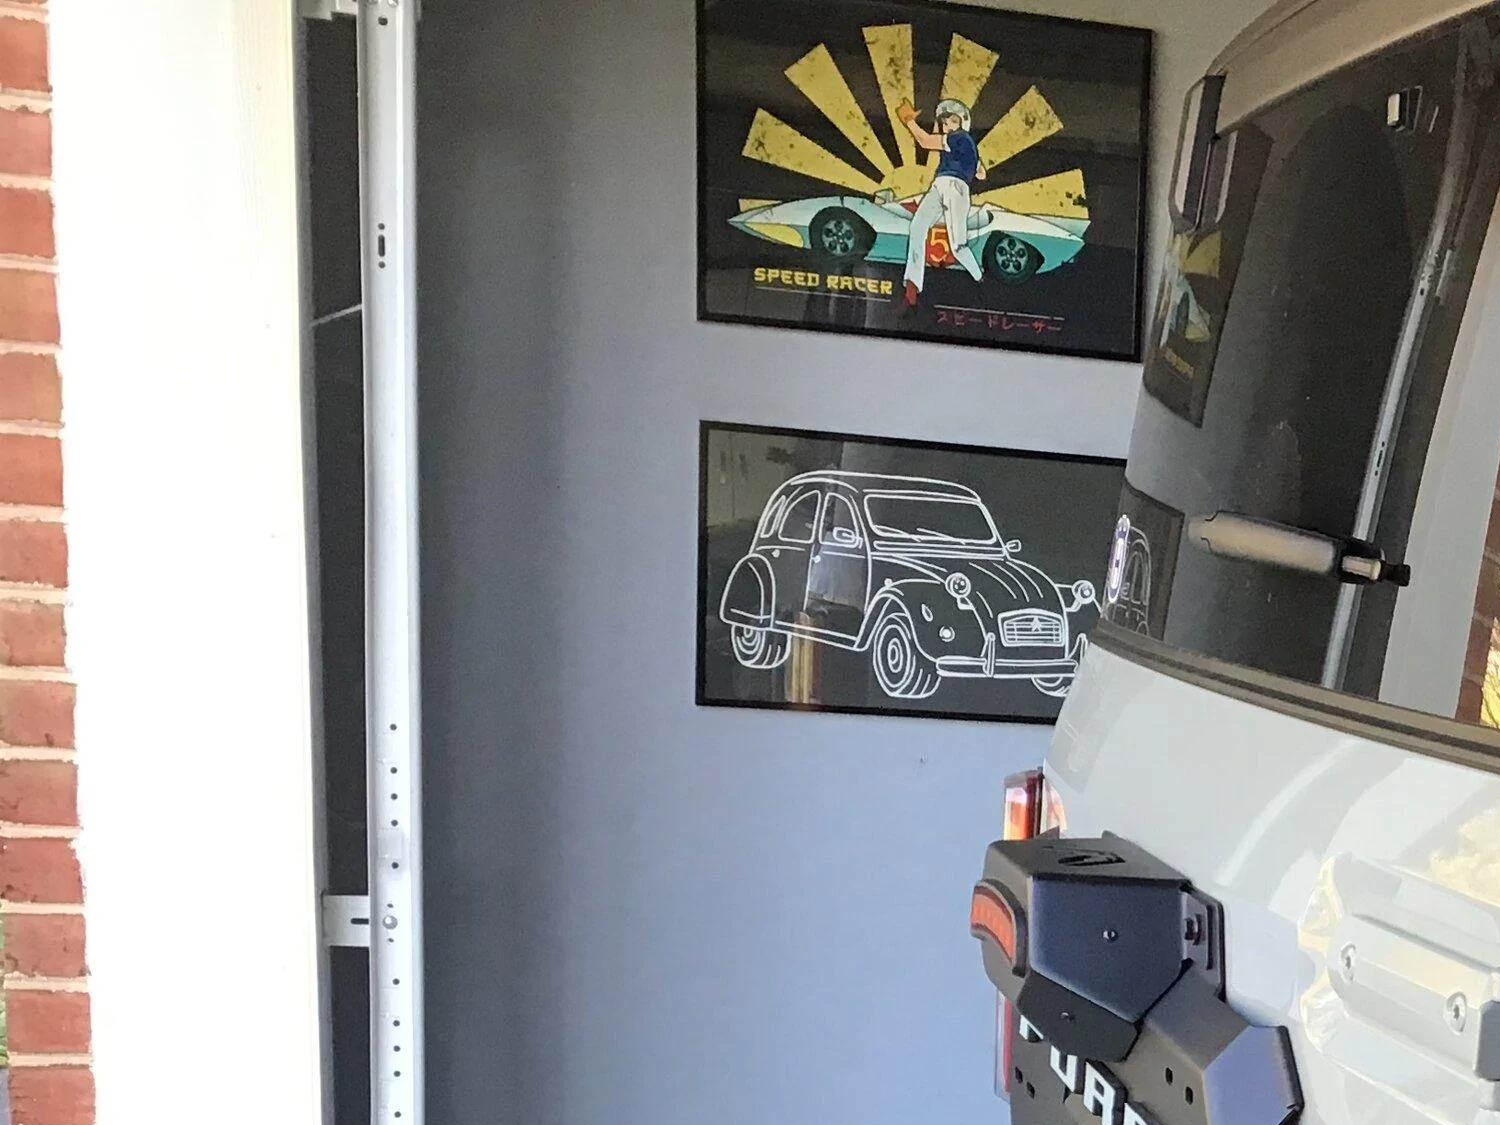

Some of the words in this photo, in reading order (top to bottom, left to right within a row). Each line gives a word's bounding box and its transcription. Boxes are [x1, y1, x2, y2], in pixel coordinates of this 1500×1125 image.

[930, 227, 950, 263] 5
[754, 267, 820, 287] SPEED
[826, 274, 893, 296] RACER
